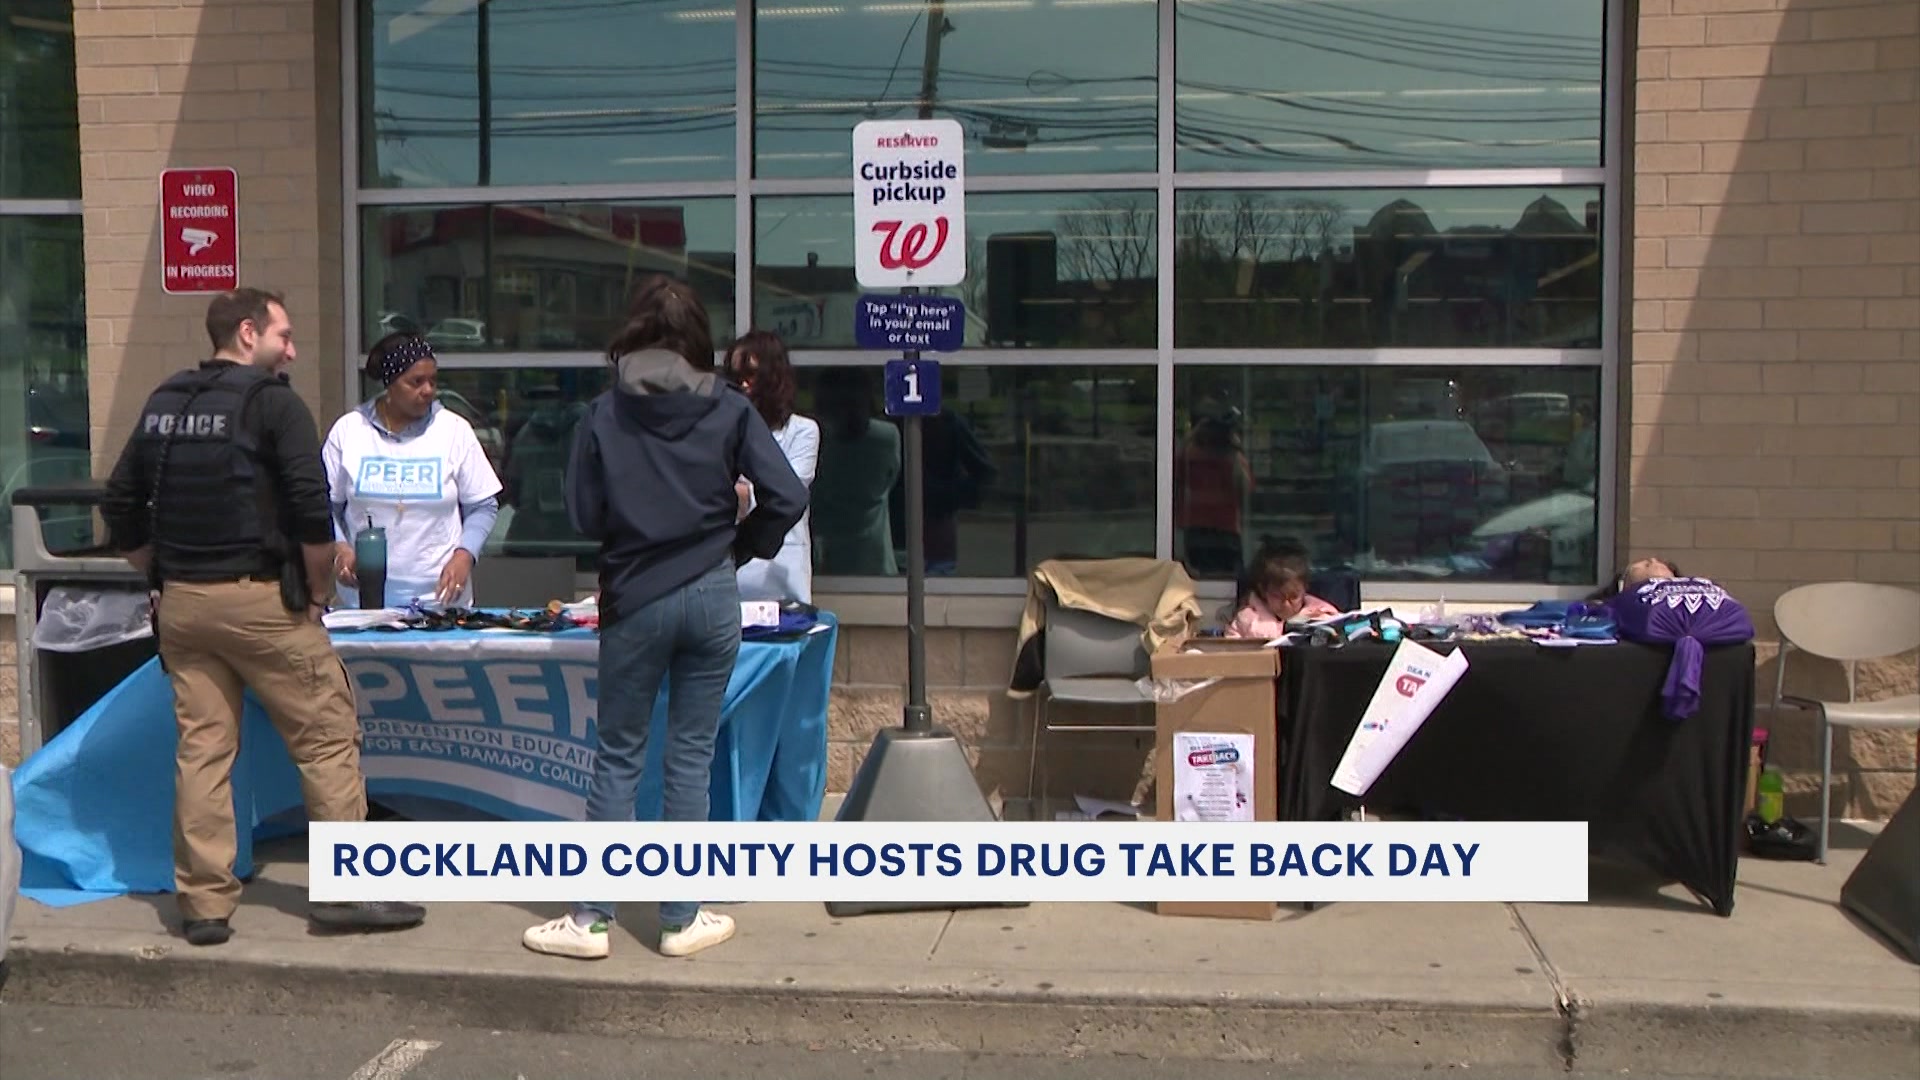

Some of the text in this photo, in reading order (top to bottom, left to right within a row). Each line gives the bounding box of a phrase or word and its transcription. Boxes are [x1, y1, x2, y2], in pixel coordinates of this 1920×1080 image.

[877, 136, 938, 148] RESERVED
[861, 160, 957, 180] Curbside
[183, 184, 216, 197] VIDEO
[873, 182, 946, 206] pickup
[170, 205, 229, 219] RECORDING
[167, 265, 234, 278] IN PROGRESS
[865, 302, 888, 316] Tap
[870, 316, 951, 331] in your email
[888, 332, 930, 345] or text
[144, 414, 226, 435] POLICE
[364, 463, 434, 482] PEER
[364, 721, 593, 769] PREVENTION EDUCATI
[364, 738, 592, 792] FOR EAST RAMAPO COALIT
